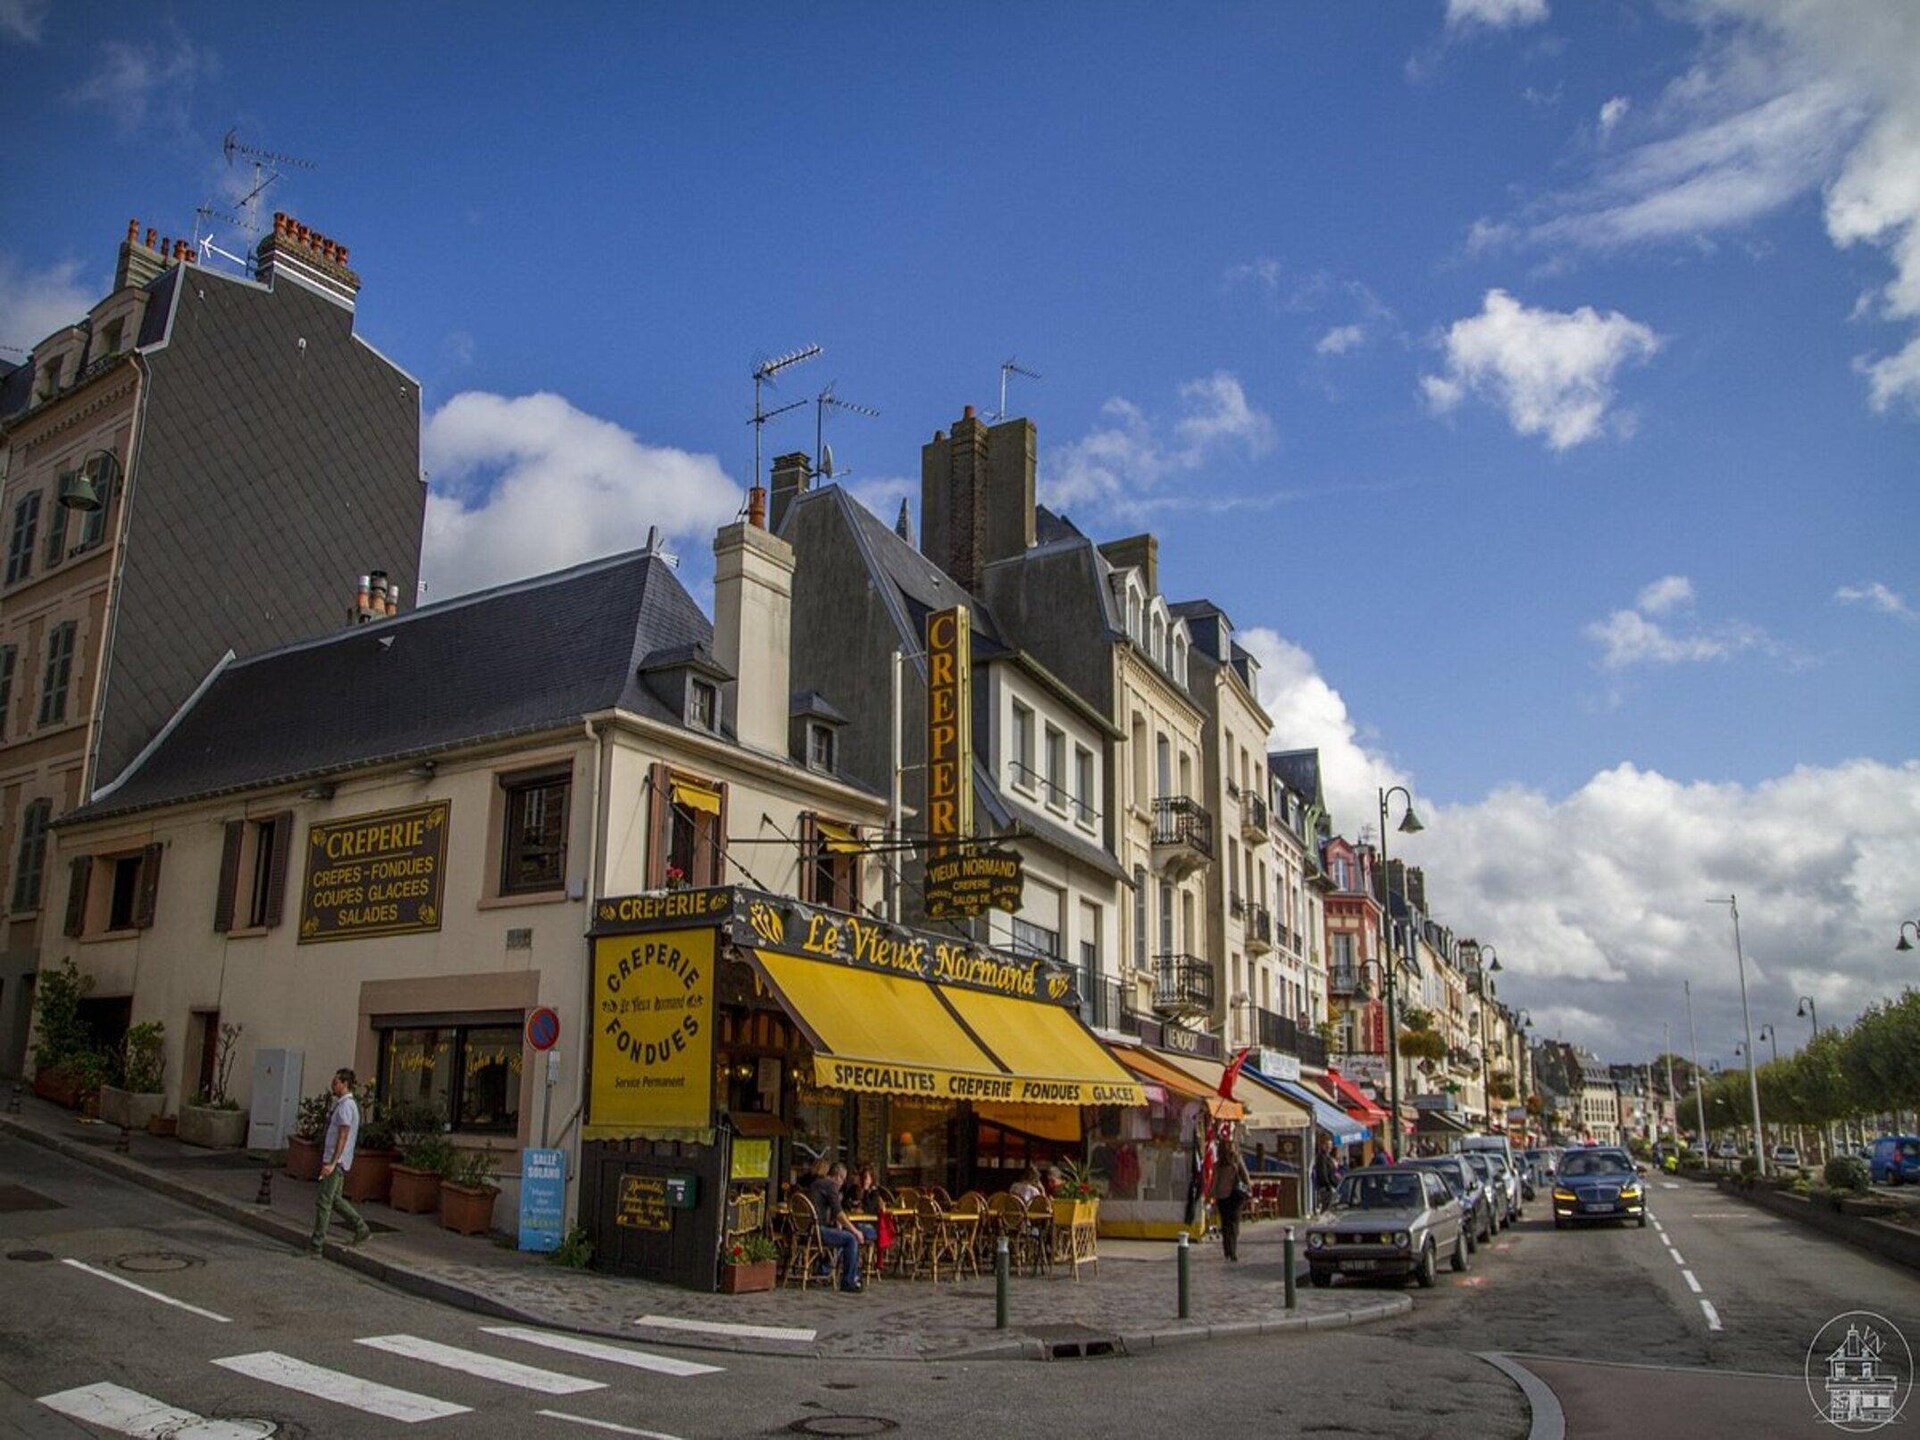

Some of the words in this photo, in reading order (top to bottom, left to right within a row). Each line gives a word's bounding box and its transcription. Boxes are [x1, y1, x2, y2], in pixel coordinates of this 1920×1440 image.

[327, 820, 423, 858] CREPERIE
[313, 866, 361, 887] CREPES
[371, 856, 433, 880] FONDUES
[930, 861, 959, 884] VIEUX
[962, 859, 1016, 878] NORMAND
[313, 887, 363, 908] COUPES
[368, 879, 429, 901] GLACEES
[619, 892, 707, 921] CREPERIE
[338, 904, 398, 926] SALADES
[607, 943, 699, 994] CREPERIE
[802, 914, 838, 955] Le
[847, 917, 923, 972] Vieux
[934, 943, 1039, 994] Normand
[605, 1014, 699, 1065] FONDUES
[835, 1064, 935, 1092] SPECIALITES
[950, 1076, 1011, 1098] CREPERIE
[1022, 1082, 1080, 1100] FONDUES
